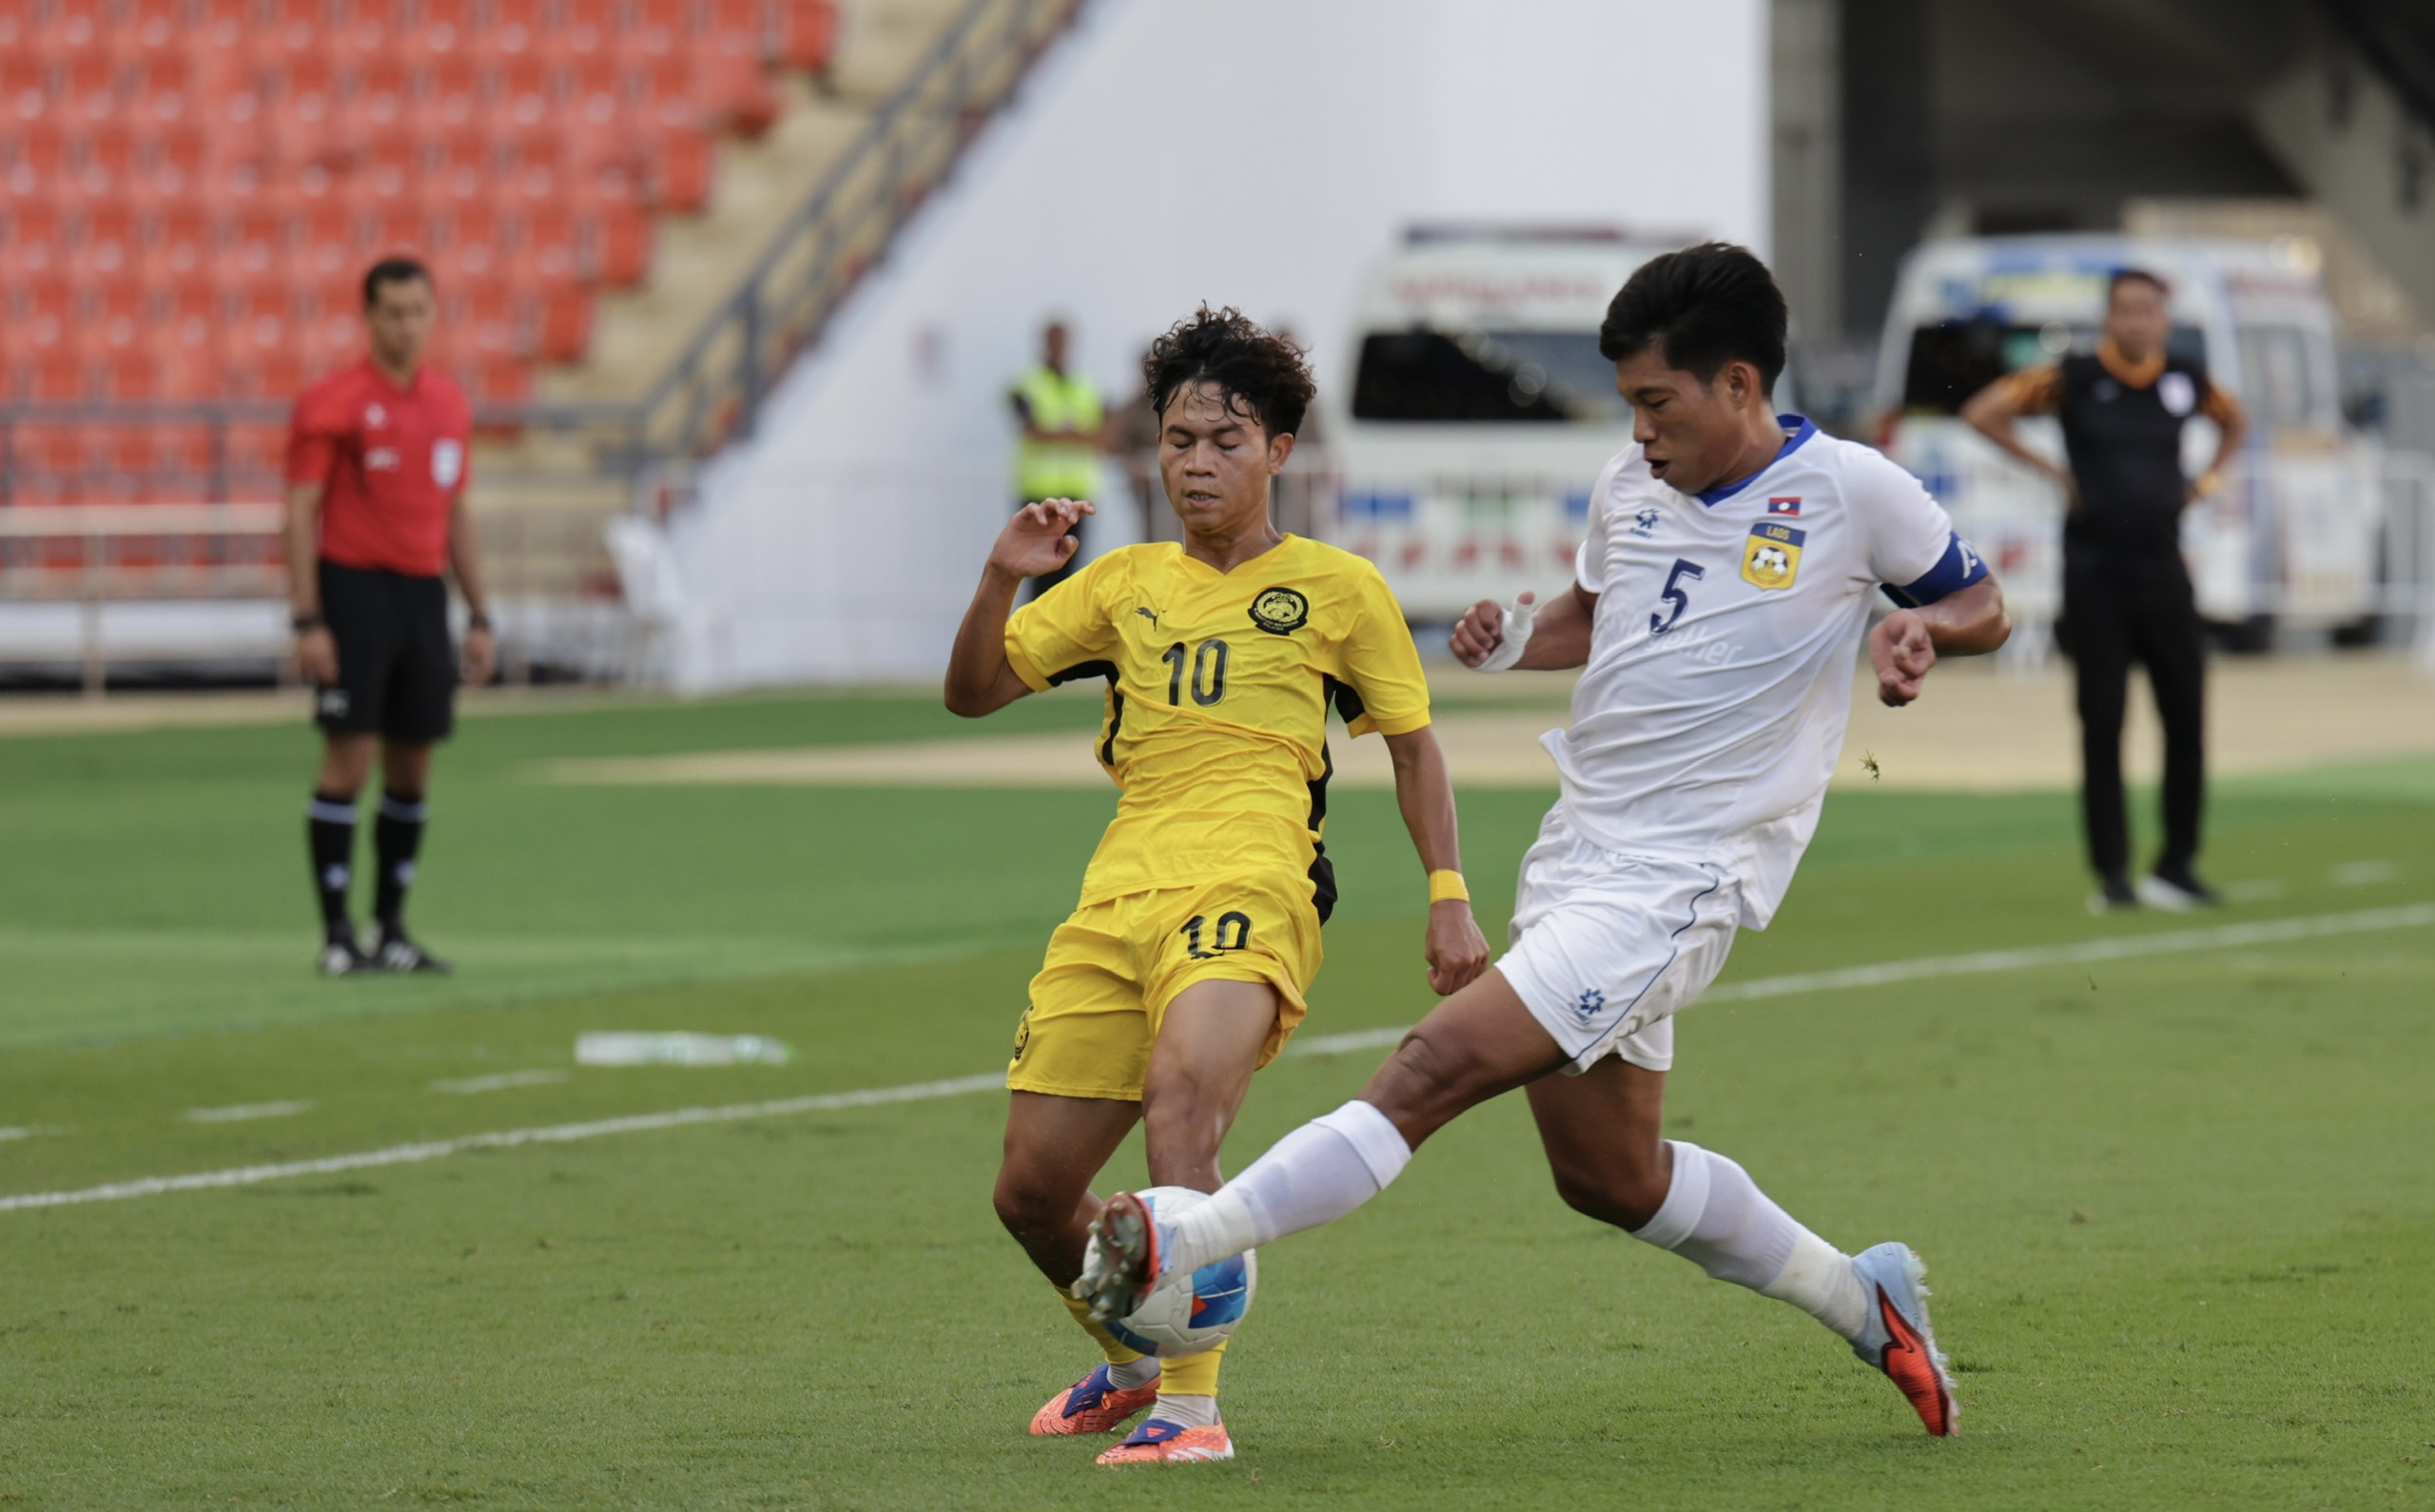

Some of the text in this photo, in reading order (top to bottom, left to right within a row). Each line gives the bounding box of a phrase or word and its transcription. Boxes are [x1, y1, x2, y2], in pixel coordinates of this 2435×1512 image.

[1765, 526, 1790, 541] LAOS
[1649, 557, 1705, 636] 5
[1161, 638, 1230, 708] 10
[1180, 910, 1253, 960] 10
